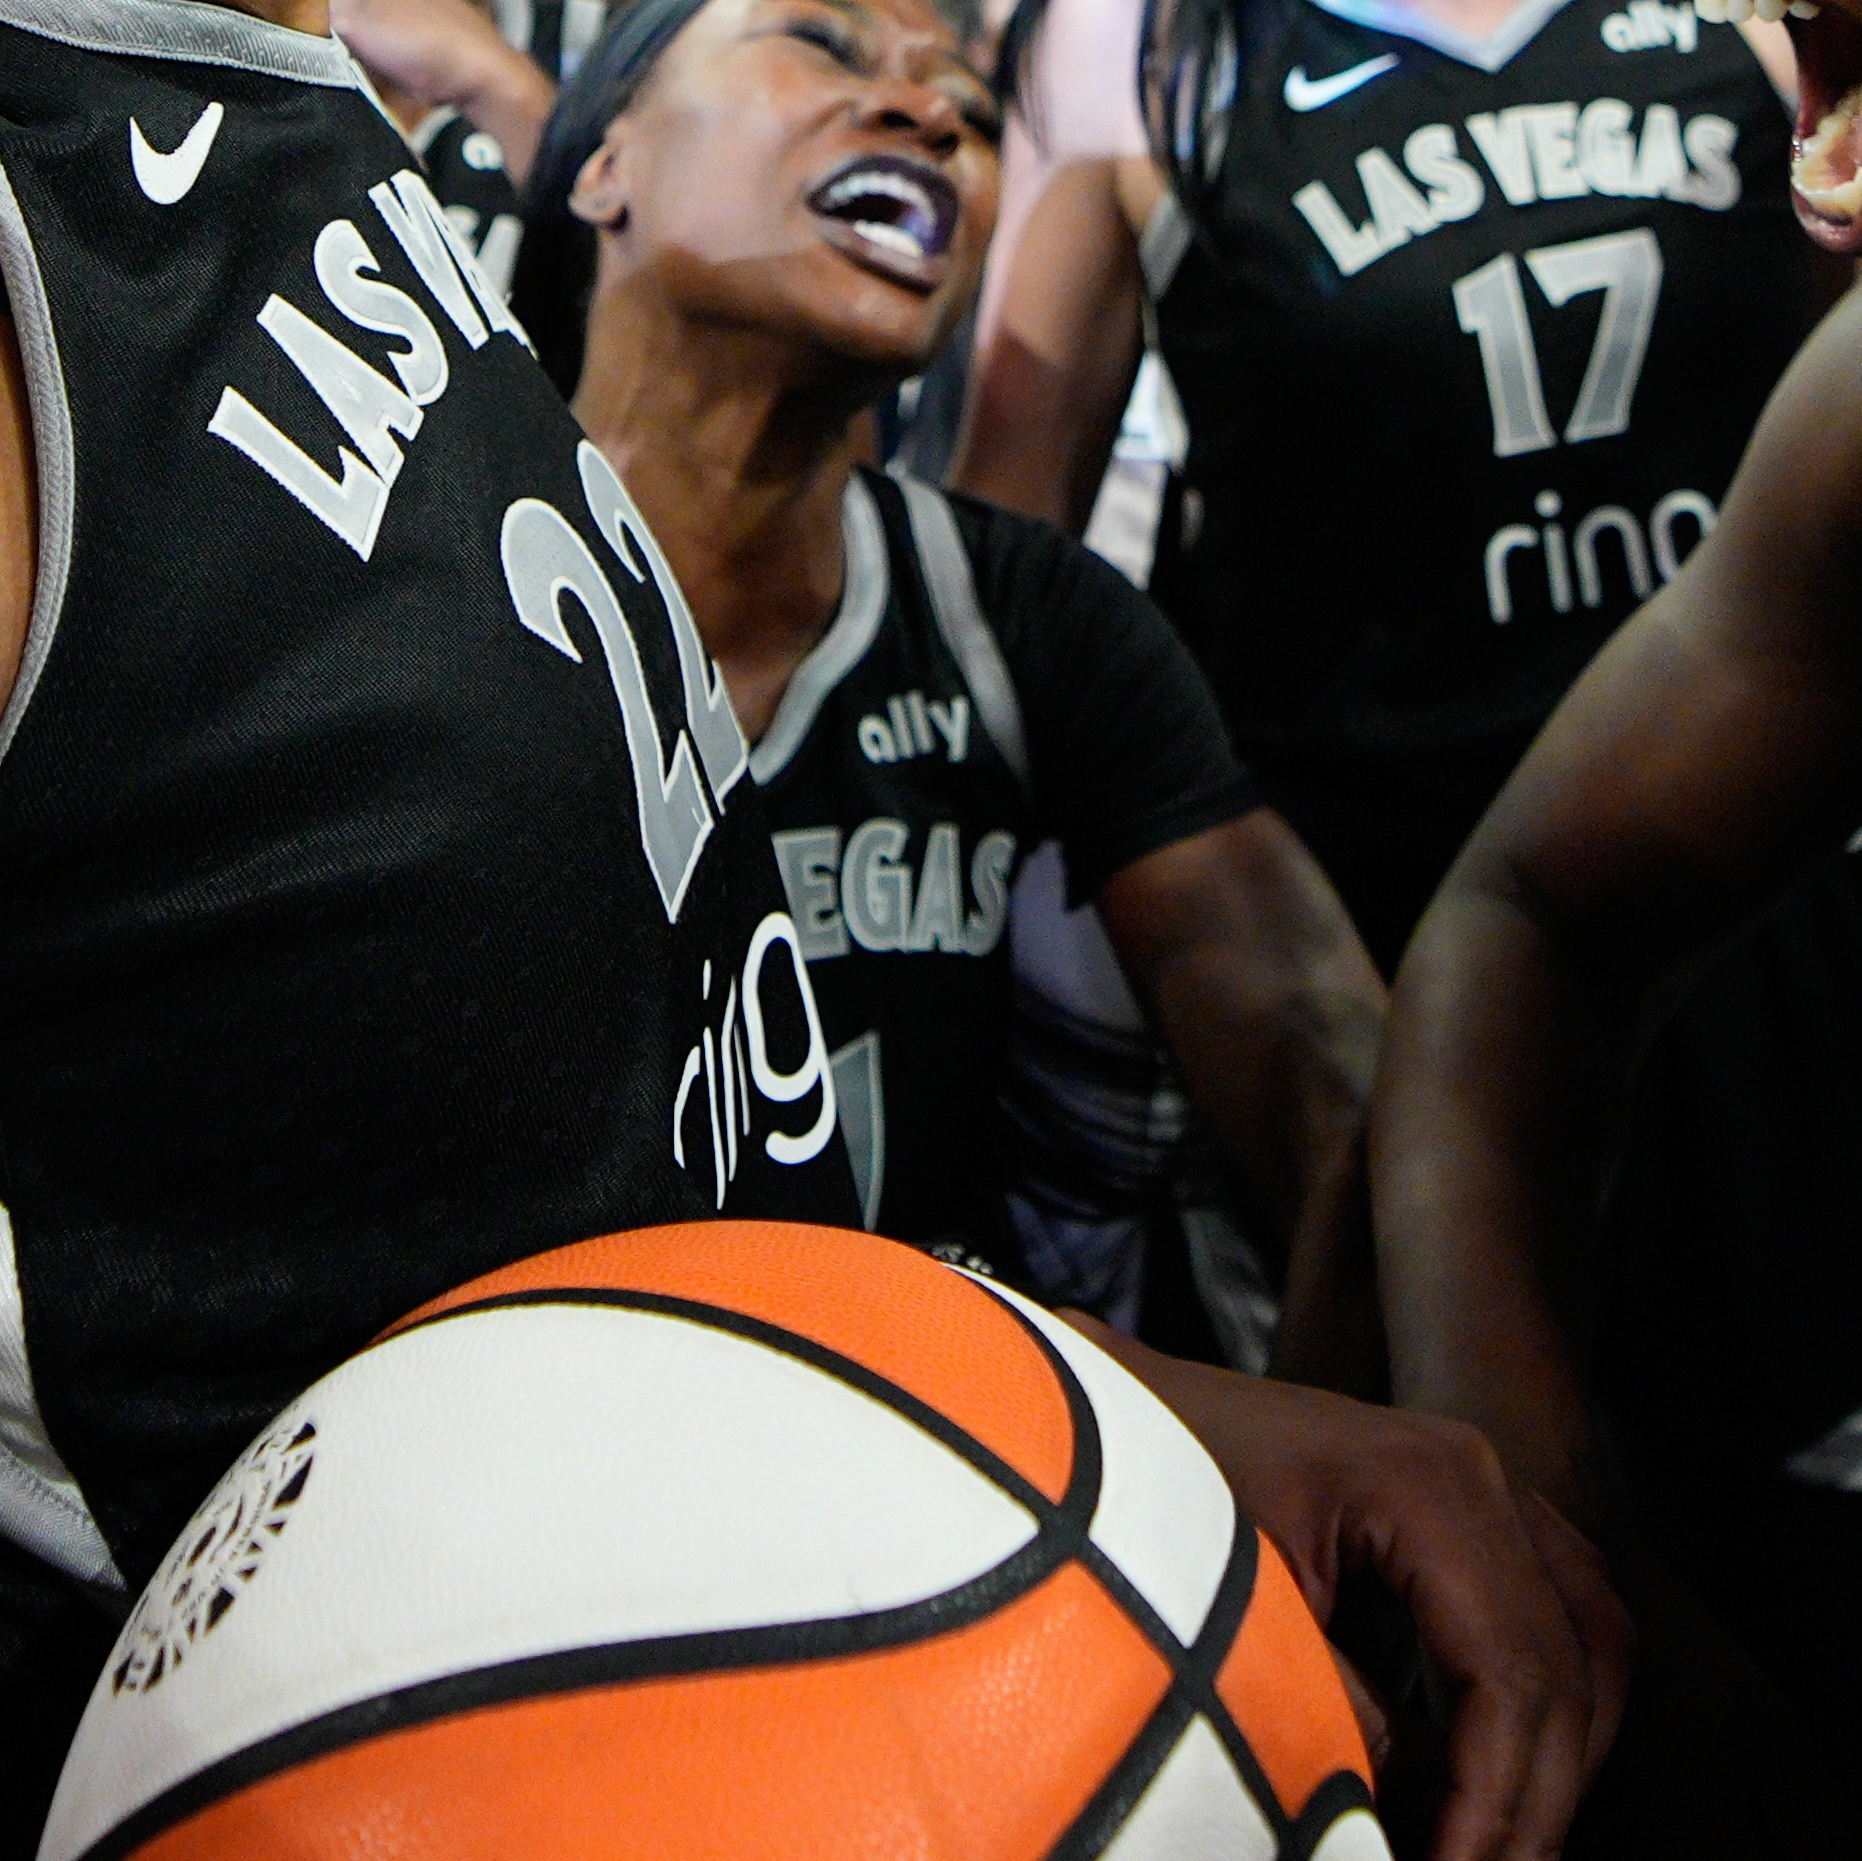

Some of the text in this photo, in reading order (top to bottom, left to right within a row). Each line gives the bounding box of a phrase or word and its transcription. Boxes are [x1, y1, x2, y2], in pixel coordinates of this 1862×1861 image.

[1291, 97, 1741, 277] LAS VEGAS
[209, 219, 449, 563] LAS
[1452, 226, 1665, 459] 17
[500, 438, 750, 925] 22
[857, 690, 970, 765] ally
[771, 816, 1019, 962] EGAS
